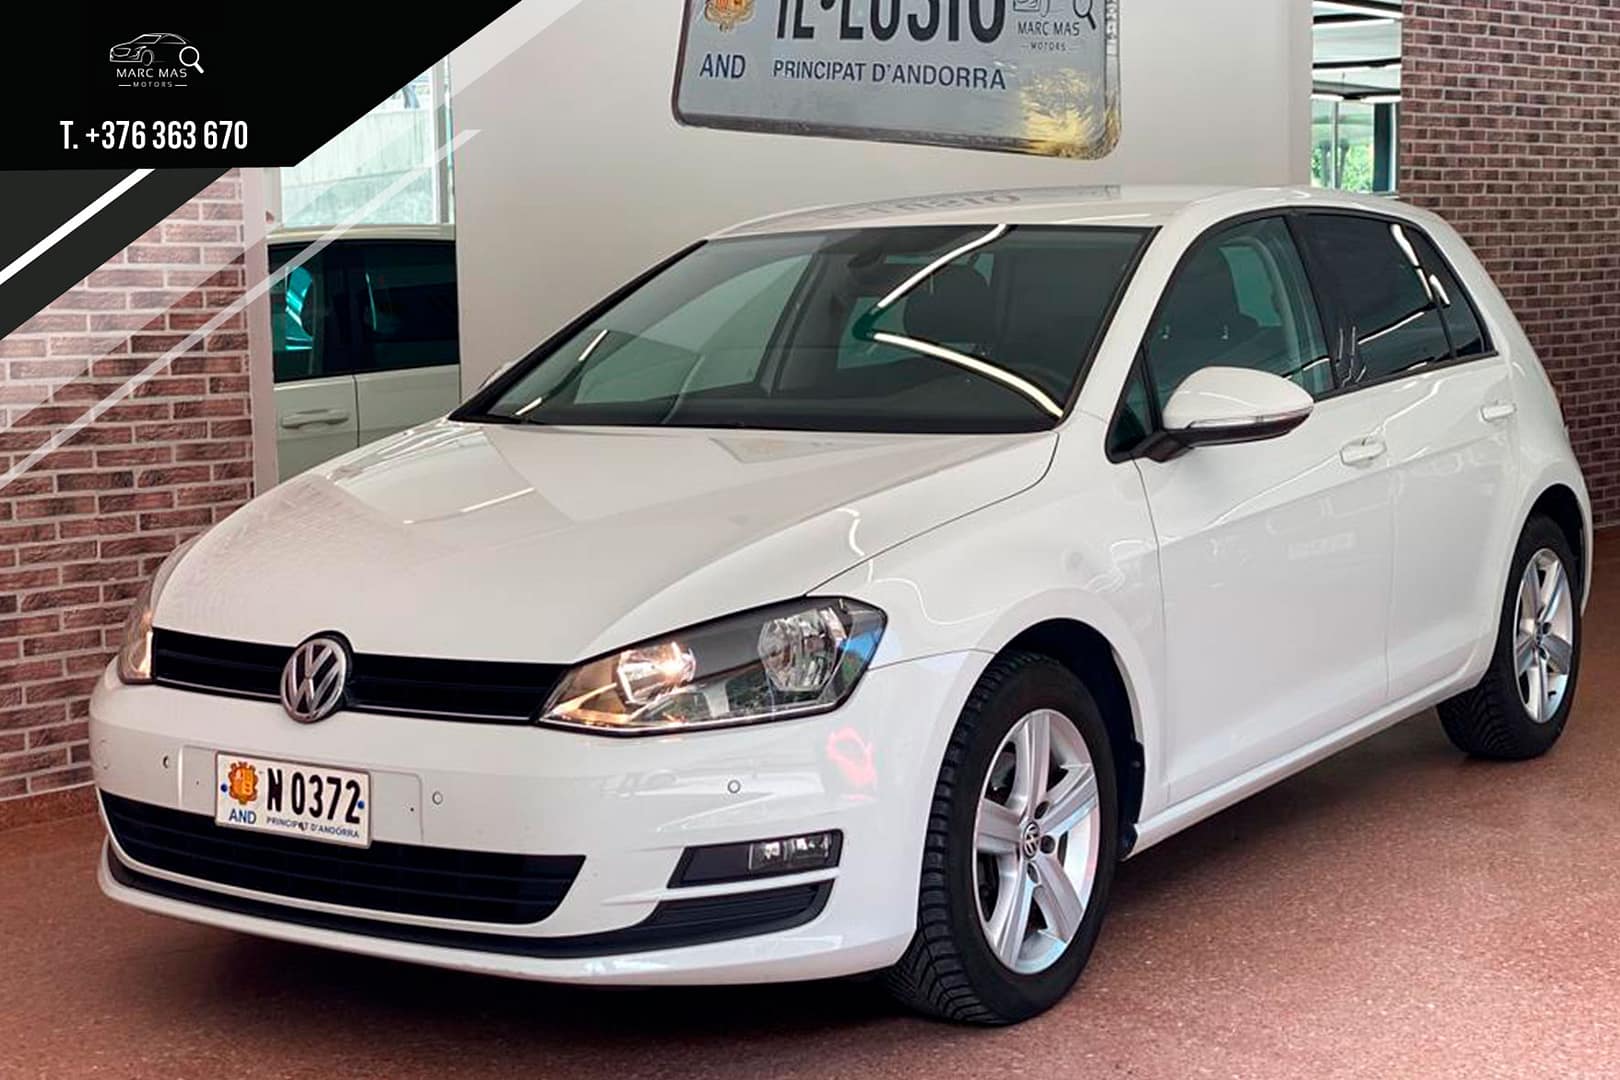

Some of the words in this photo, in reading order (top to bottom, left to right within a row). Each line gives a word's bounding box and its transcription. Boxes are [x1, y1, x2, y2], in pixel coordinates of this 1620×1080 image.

[1017, 21, 1049, 36] MARC
[1053, 21, 1080, 37] MAS
[700, 53, 746, 79] AND
[773, 59, 867, 82] PRINCIPAT
[267, 767, 283, 812] N
[291, 771, 361, 824] 0372
[228, 808, 257, 825] AND
